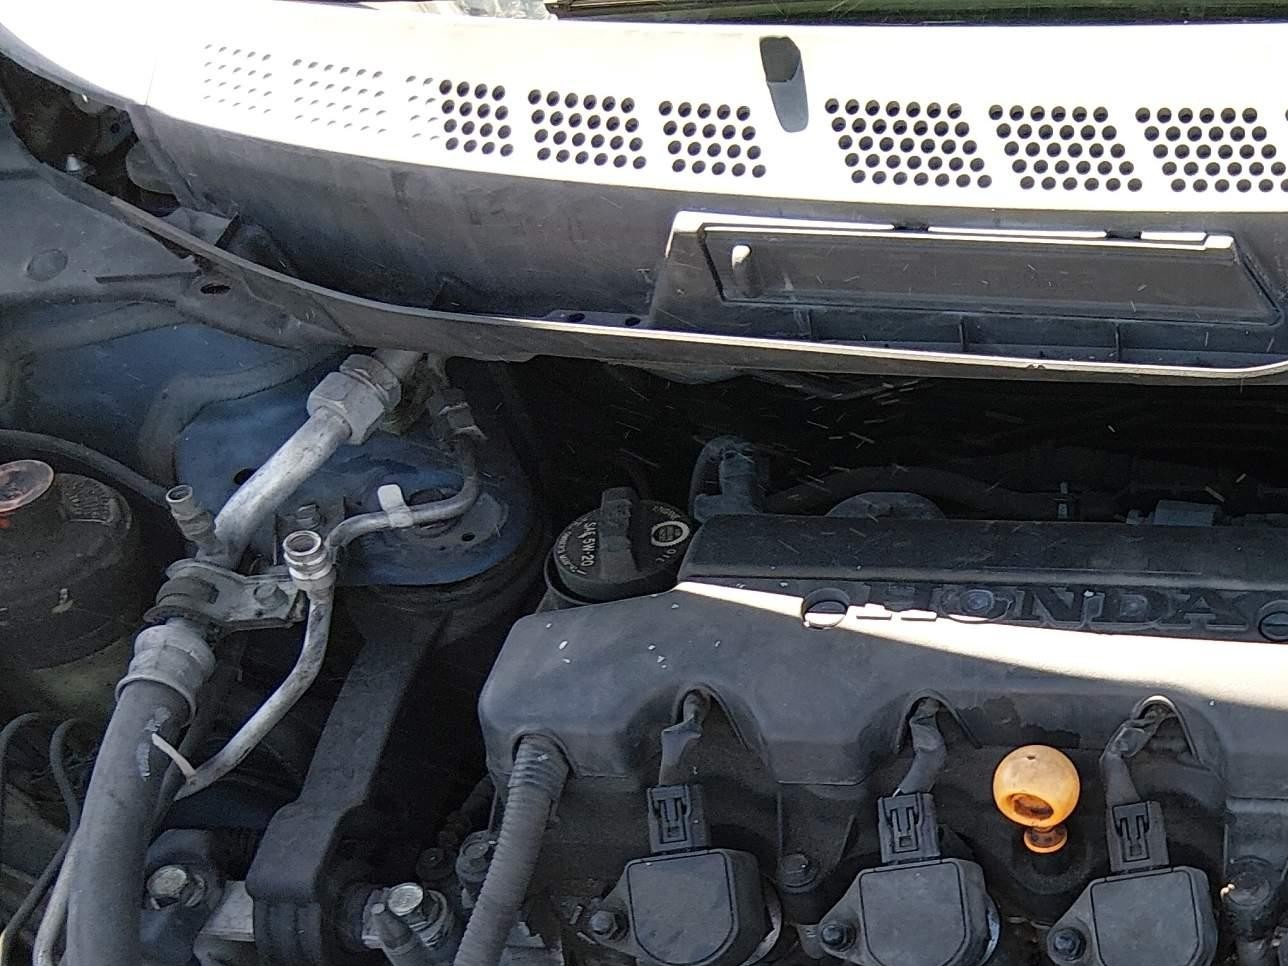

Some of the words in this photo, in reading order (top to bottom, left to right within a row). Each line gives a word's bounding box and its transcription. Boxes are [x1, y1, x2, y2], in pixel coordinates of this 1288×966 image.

[583, 521, 597, 538] SAE
[580, 537, 596, 567] 5W-20
[655, 548, 677, 563] OIL
[853, 583, 1249, 633] HONDA
